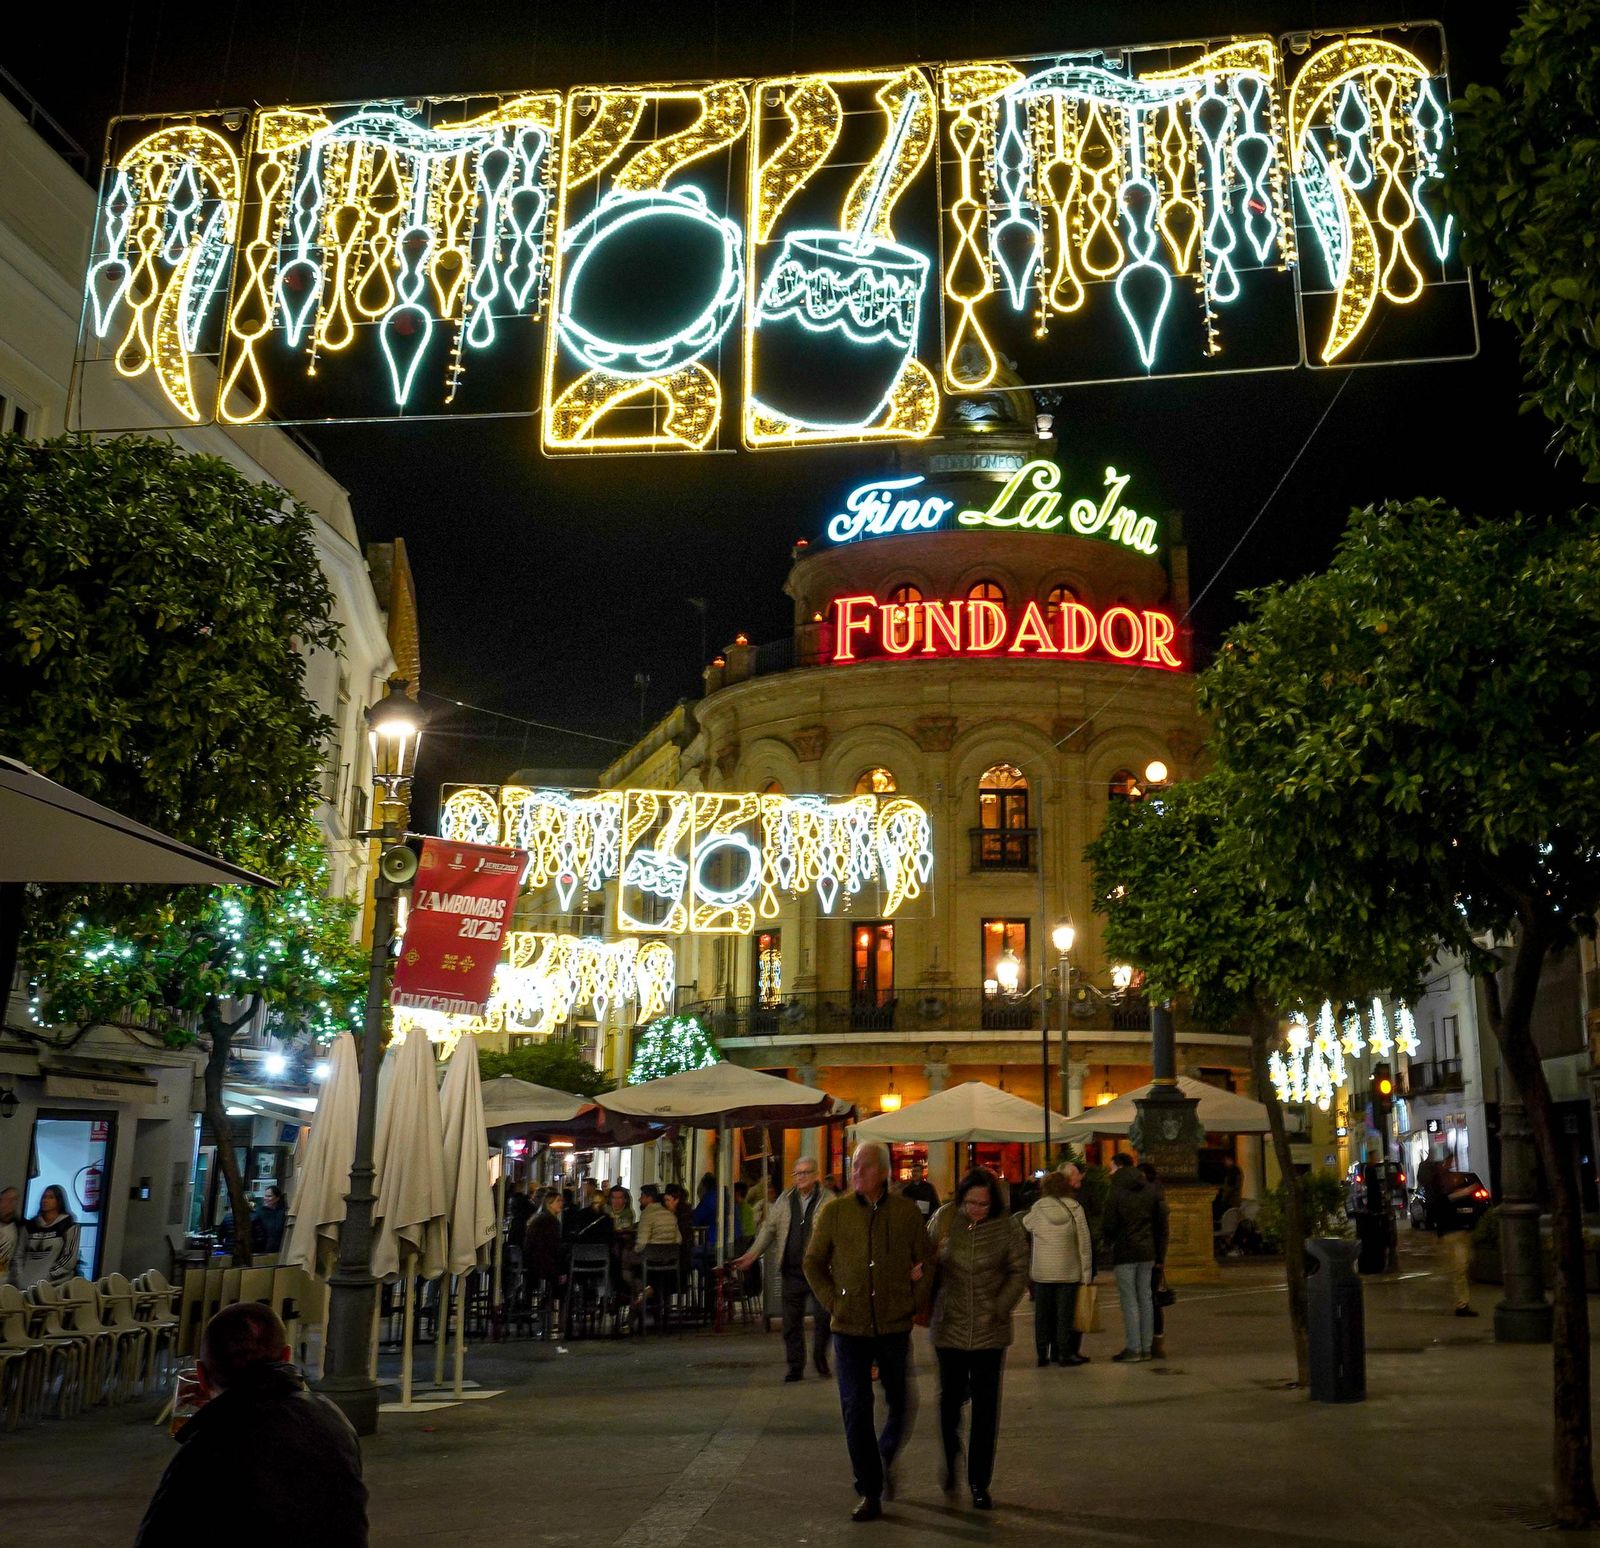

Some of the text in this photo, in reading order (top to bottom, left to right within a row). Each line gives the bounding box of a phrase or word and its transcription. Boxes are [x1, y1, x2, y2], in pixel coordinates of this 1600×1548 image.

[828, 475, 953, 542] Fino
[958, 460, 1063, 528] La
[834, 596, 1182, 667] FUNDADOR
[416, 890, 507, 919] ZAMBOMBAS
[458, 917, 503, 941] 2025
